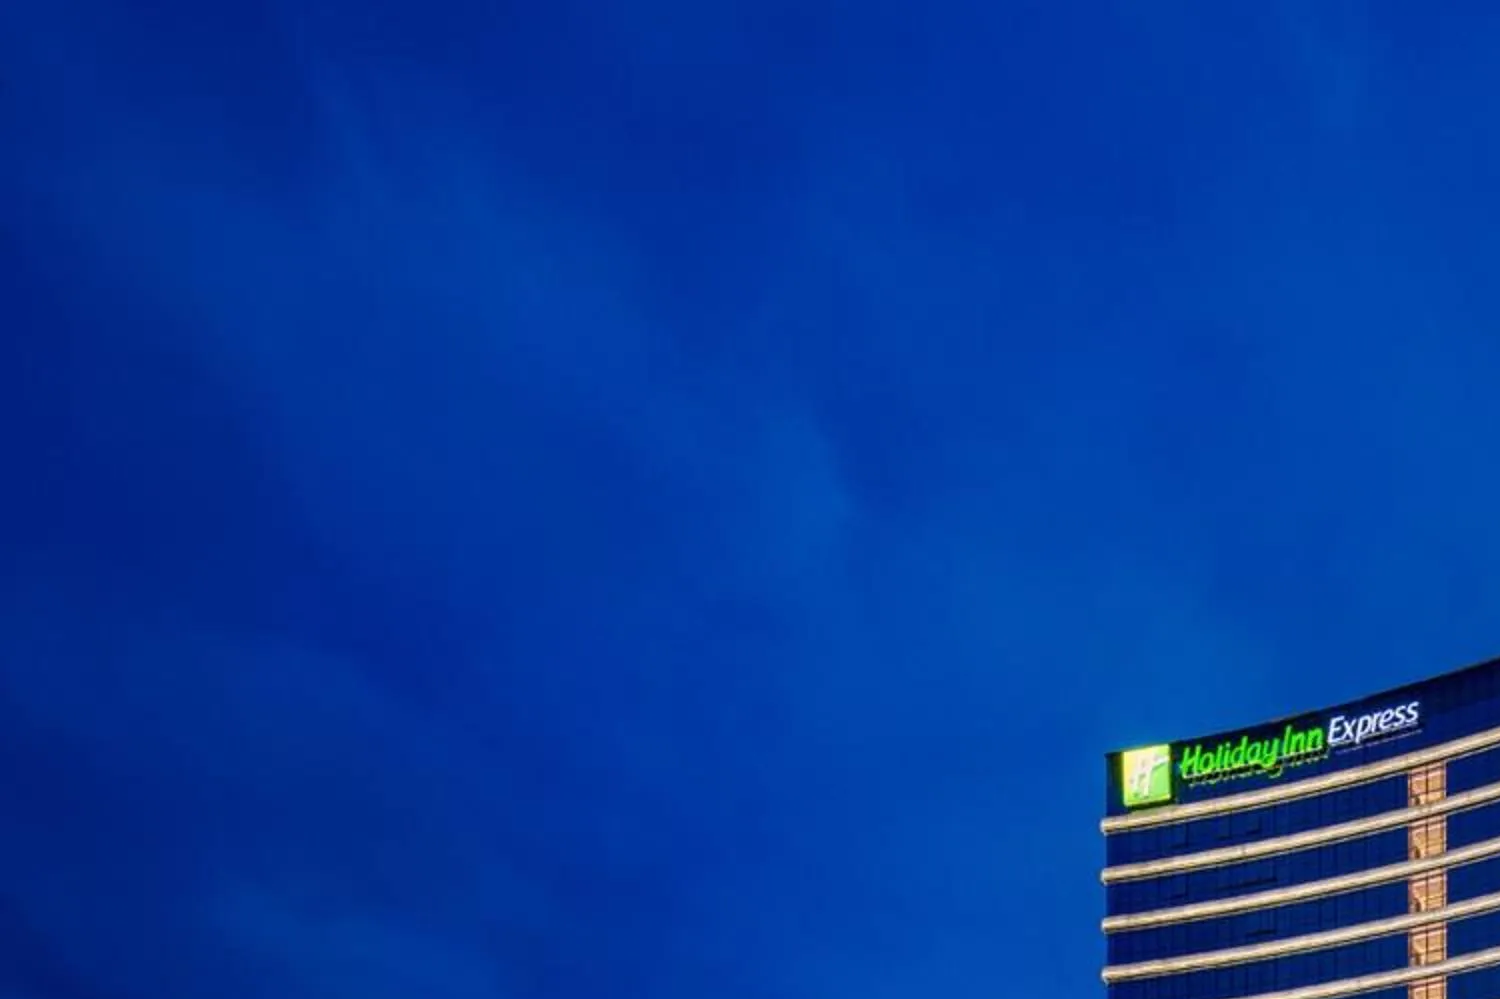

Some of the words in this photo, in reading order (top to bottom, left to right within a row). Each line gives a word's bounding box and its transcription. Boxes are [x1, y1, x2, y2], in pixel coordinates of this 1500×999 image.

[1180, 736, 1280, 779] Holiday
[1283, 725, 1323, 756] Inn
[1327, 701, 1419, 745] Express
